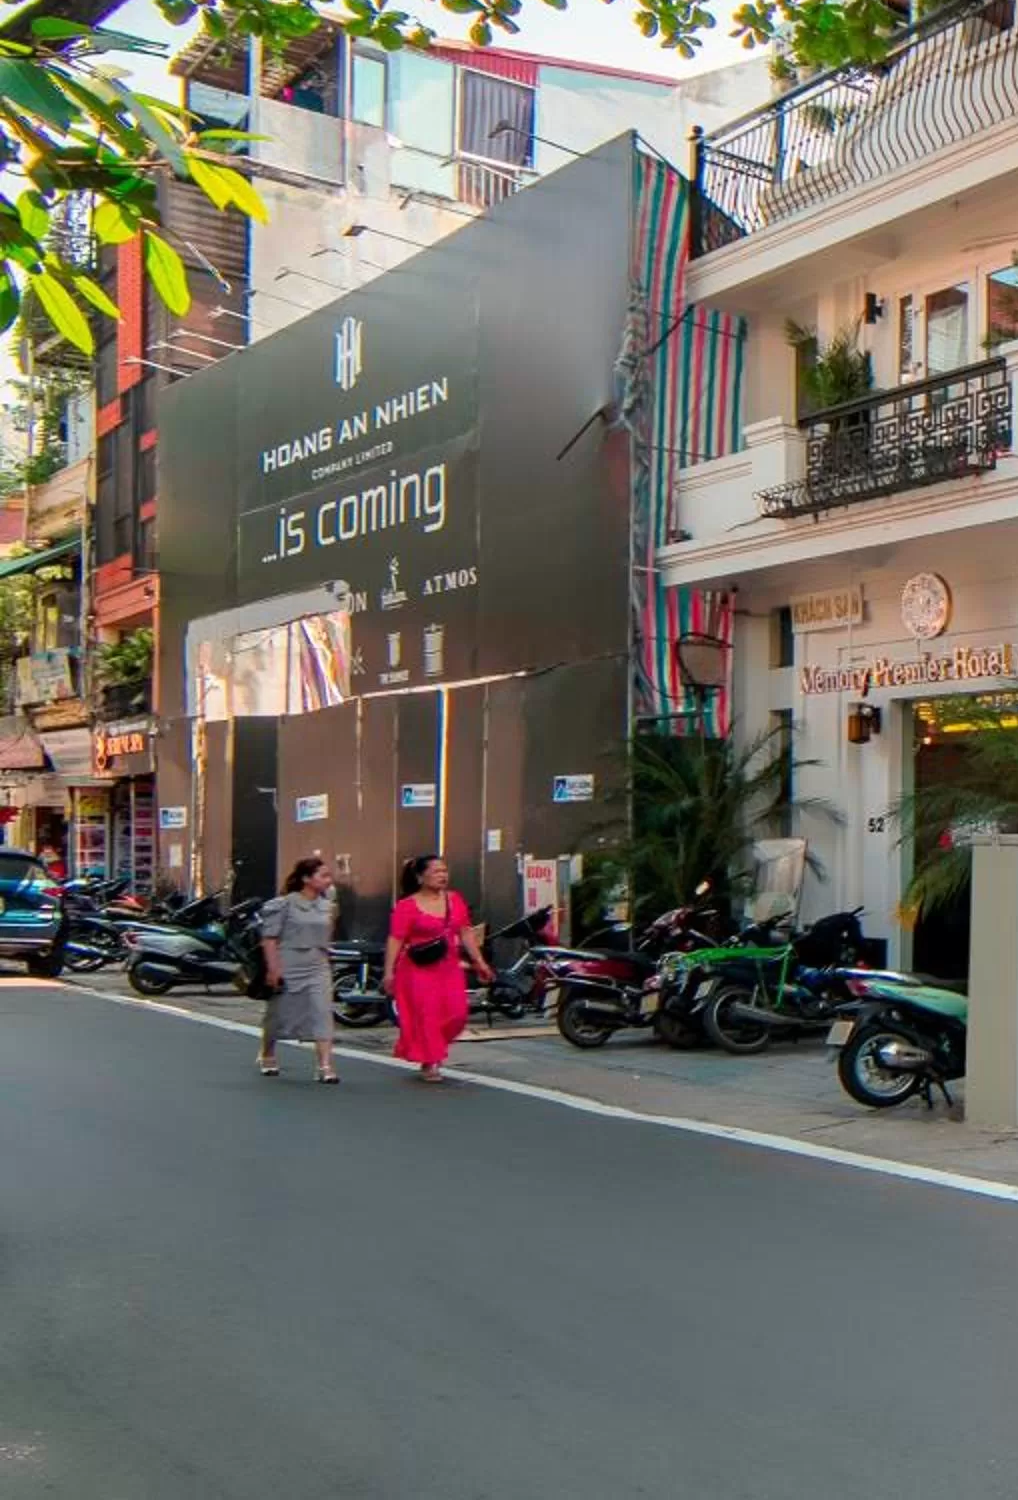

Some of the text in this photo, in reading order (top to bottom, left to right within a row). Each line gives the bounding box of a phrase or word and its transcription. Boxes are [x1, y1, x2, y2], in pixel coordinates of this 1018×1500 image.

[261, 376, 449, 474] HOANG AN NHIEN
[311, 441, 393, 481] COMPANY LIMITED
[317, 462, 448, 547] coming
[423, 566, 478, 596] ATMOS
[800, 661, 871, 698] Memory
[873, 651, 952, 689] Premier
[952, 643, 1012, 682] Hotel
[868, 817, 885, 834] 52
